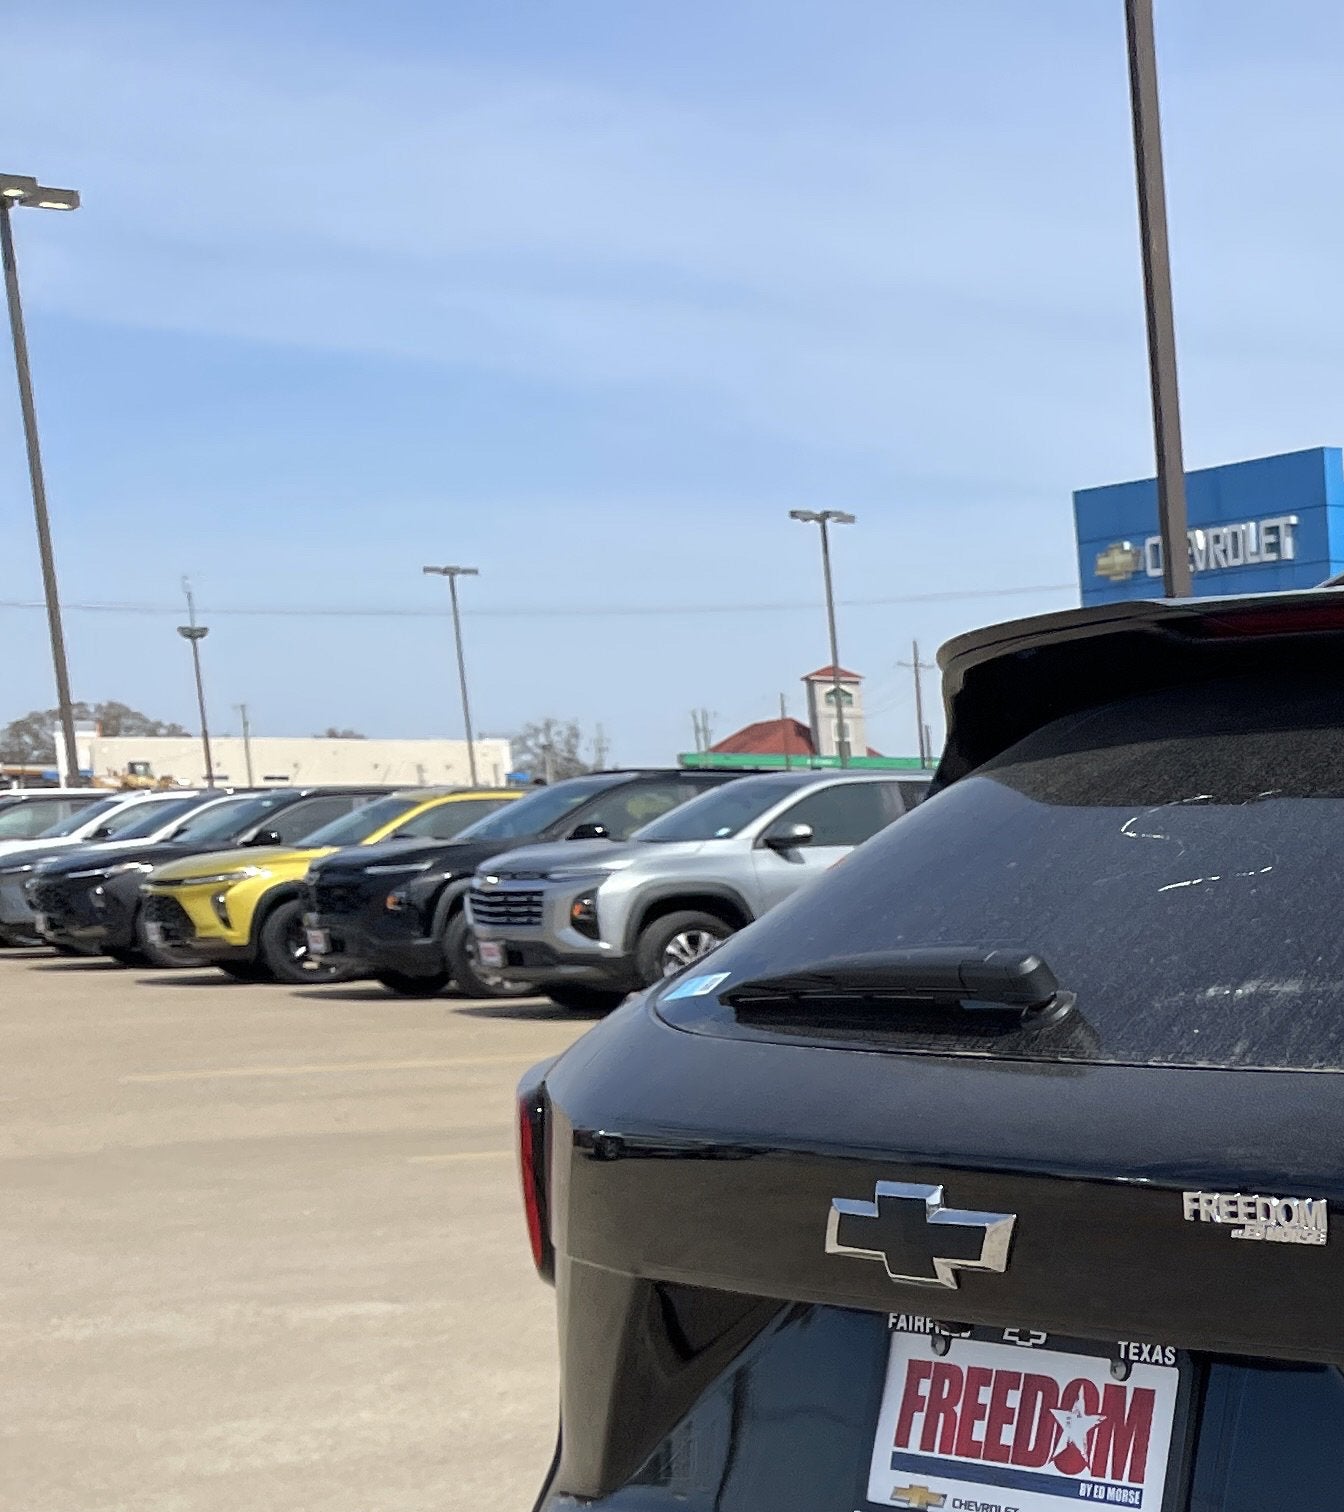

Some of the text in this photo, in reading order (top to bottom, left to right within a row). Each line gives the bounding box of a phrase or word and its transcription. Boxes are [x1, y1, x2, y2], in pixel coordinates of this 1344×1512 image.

[1145, 515, 1298, 577] CVROLET
[1182, 1191, 1328, 1231] FREEDOM
[1118, 1341, 1176, 1366] TEXAS
[893, 1358, 1157, 1485] FREEDOM
[1079, 1482, 1141, 1505] BY ED MORSE
